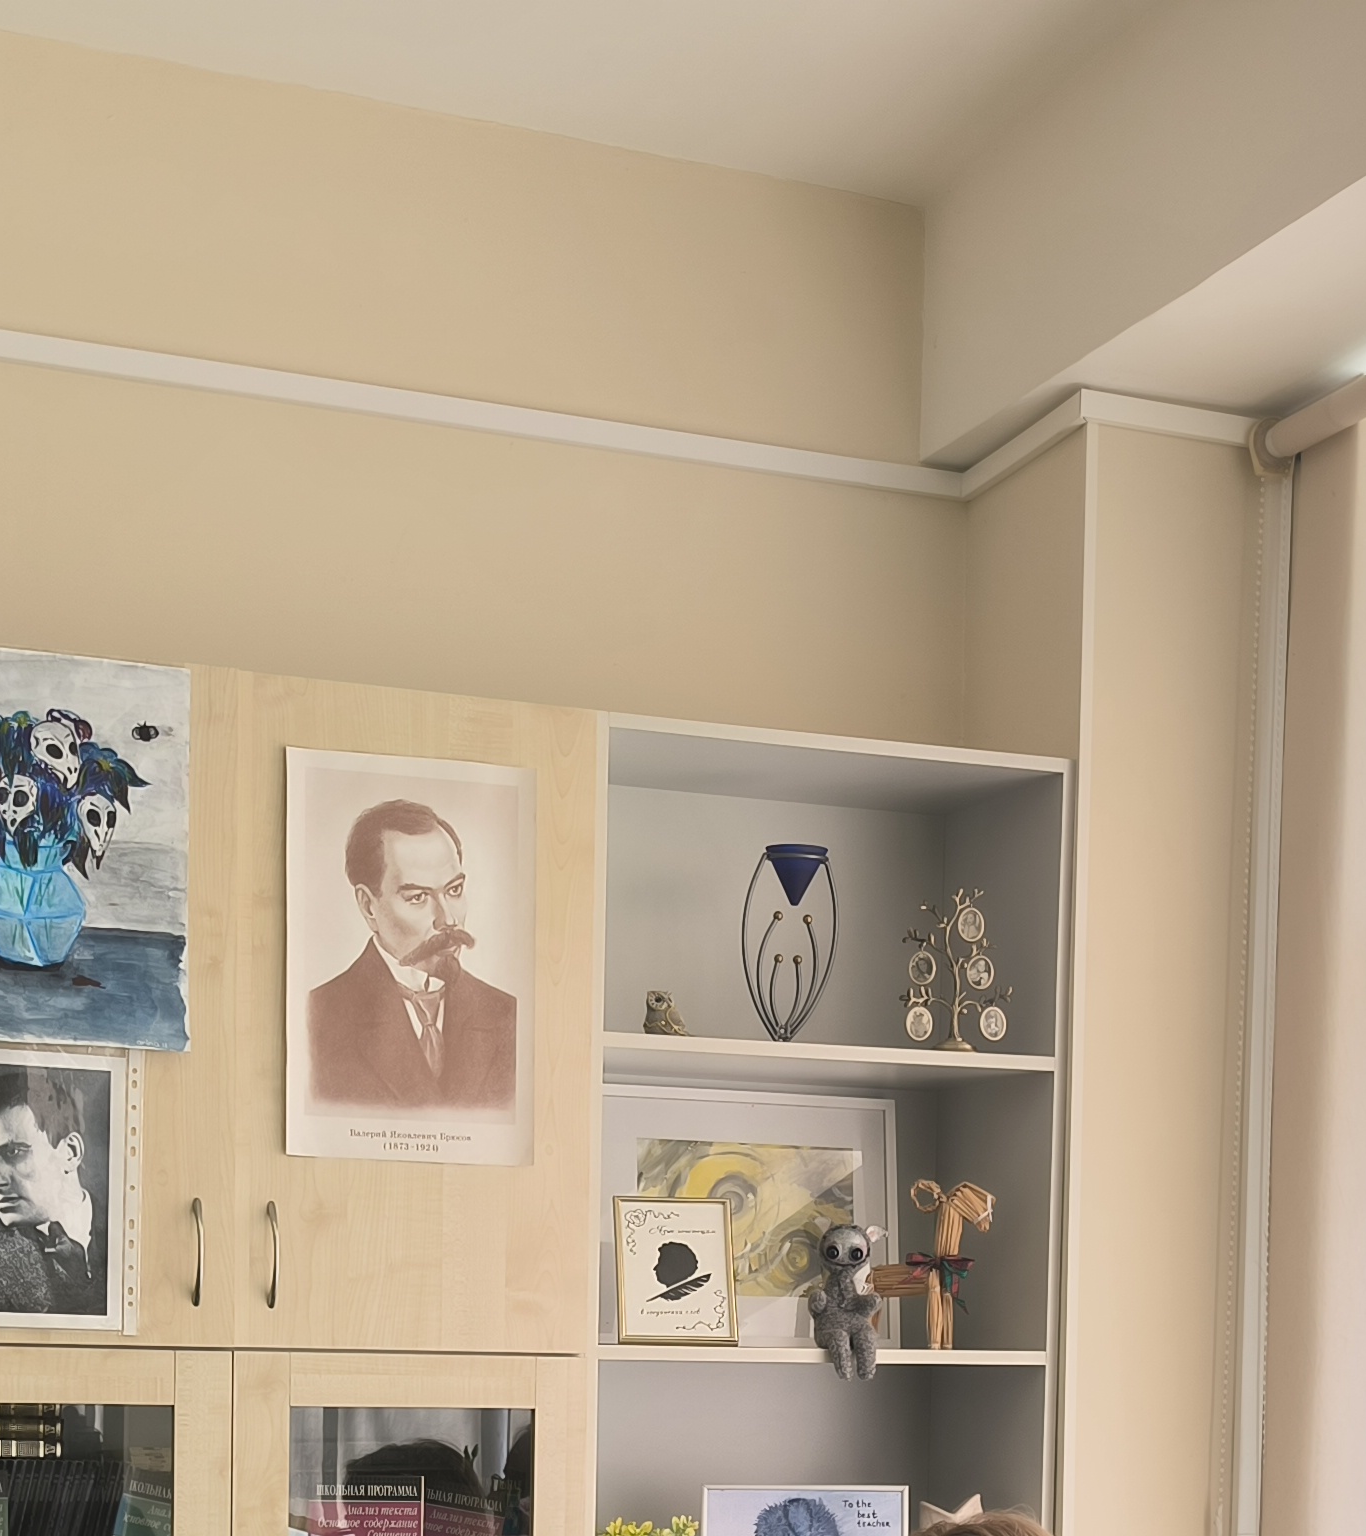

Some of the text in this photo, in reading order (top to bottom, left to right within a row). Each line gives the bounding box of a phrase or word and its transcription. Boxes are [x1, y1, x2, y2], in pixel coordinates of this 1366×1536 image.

[316, 1484, 418, 1497] ШКОЛЬНАЯ ПРОГРАММА
[842, 1499, 872, 1508] To the
[346, 1504, 418, 1516] Анализ текста
[857, 1509, 878, 1519] best
[429, 1510, 462, 1525] Анализ
[363, 1518, 418, 1533] содержание
